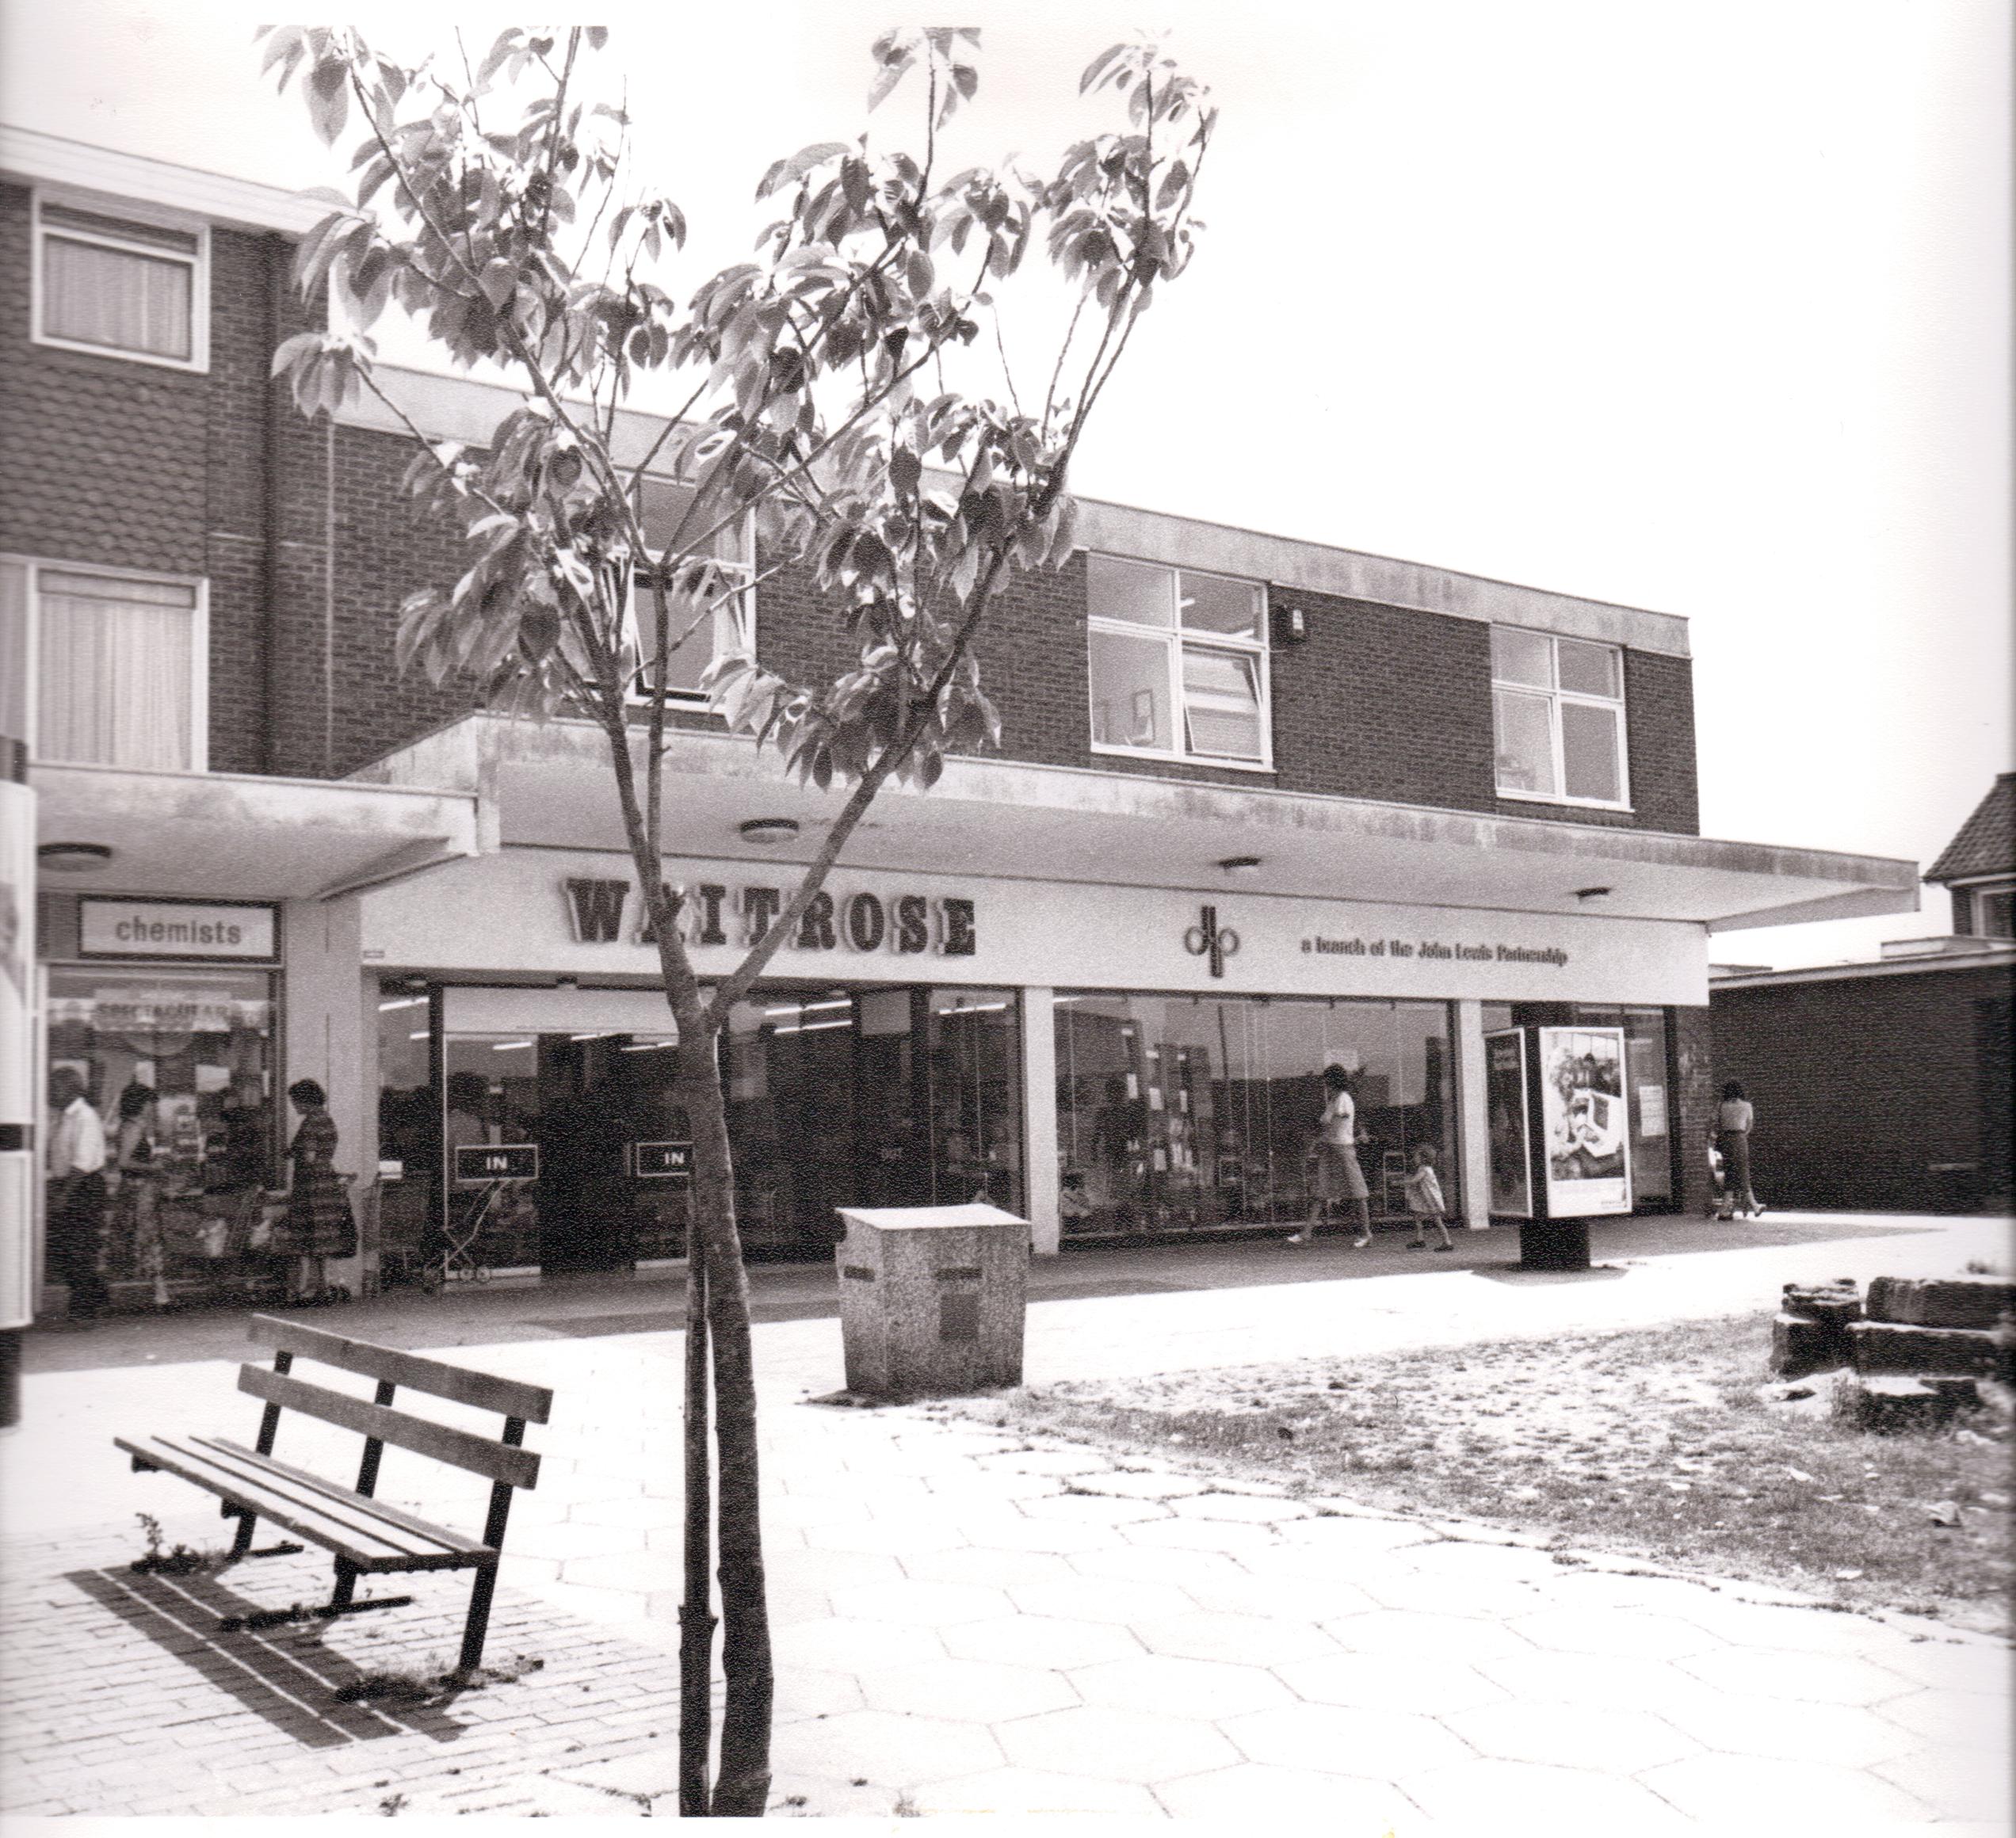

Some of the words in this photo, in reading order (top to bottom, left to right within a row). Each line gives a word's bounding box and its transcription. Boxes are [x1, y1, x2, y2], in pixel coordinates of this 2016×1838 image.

[116, 916, 241, 944] chemists
[1300, 940, 1312, 953] a
[1315, 936, 1366, 955] branch
[1369, 939, 1385, 956] of
[1390, 940, 1414, 957] the
[1418, 941, 1452, 959] John
[1455, 943, 1494, 961] Lewis
[1496, 944, 1569, 967] Partnership
[486, 1156, 508, 1170] IN
[664, 1151, 685, 1165] IN
